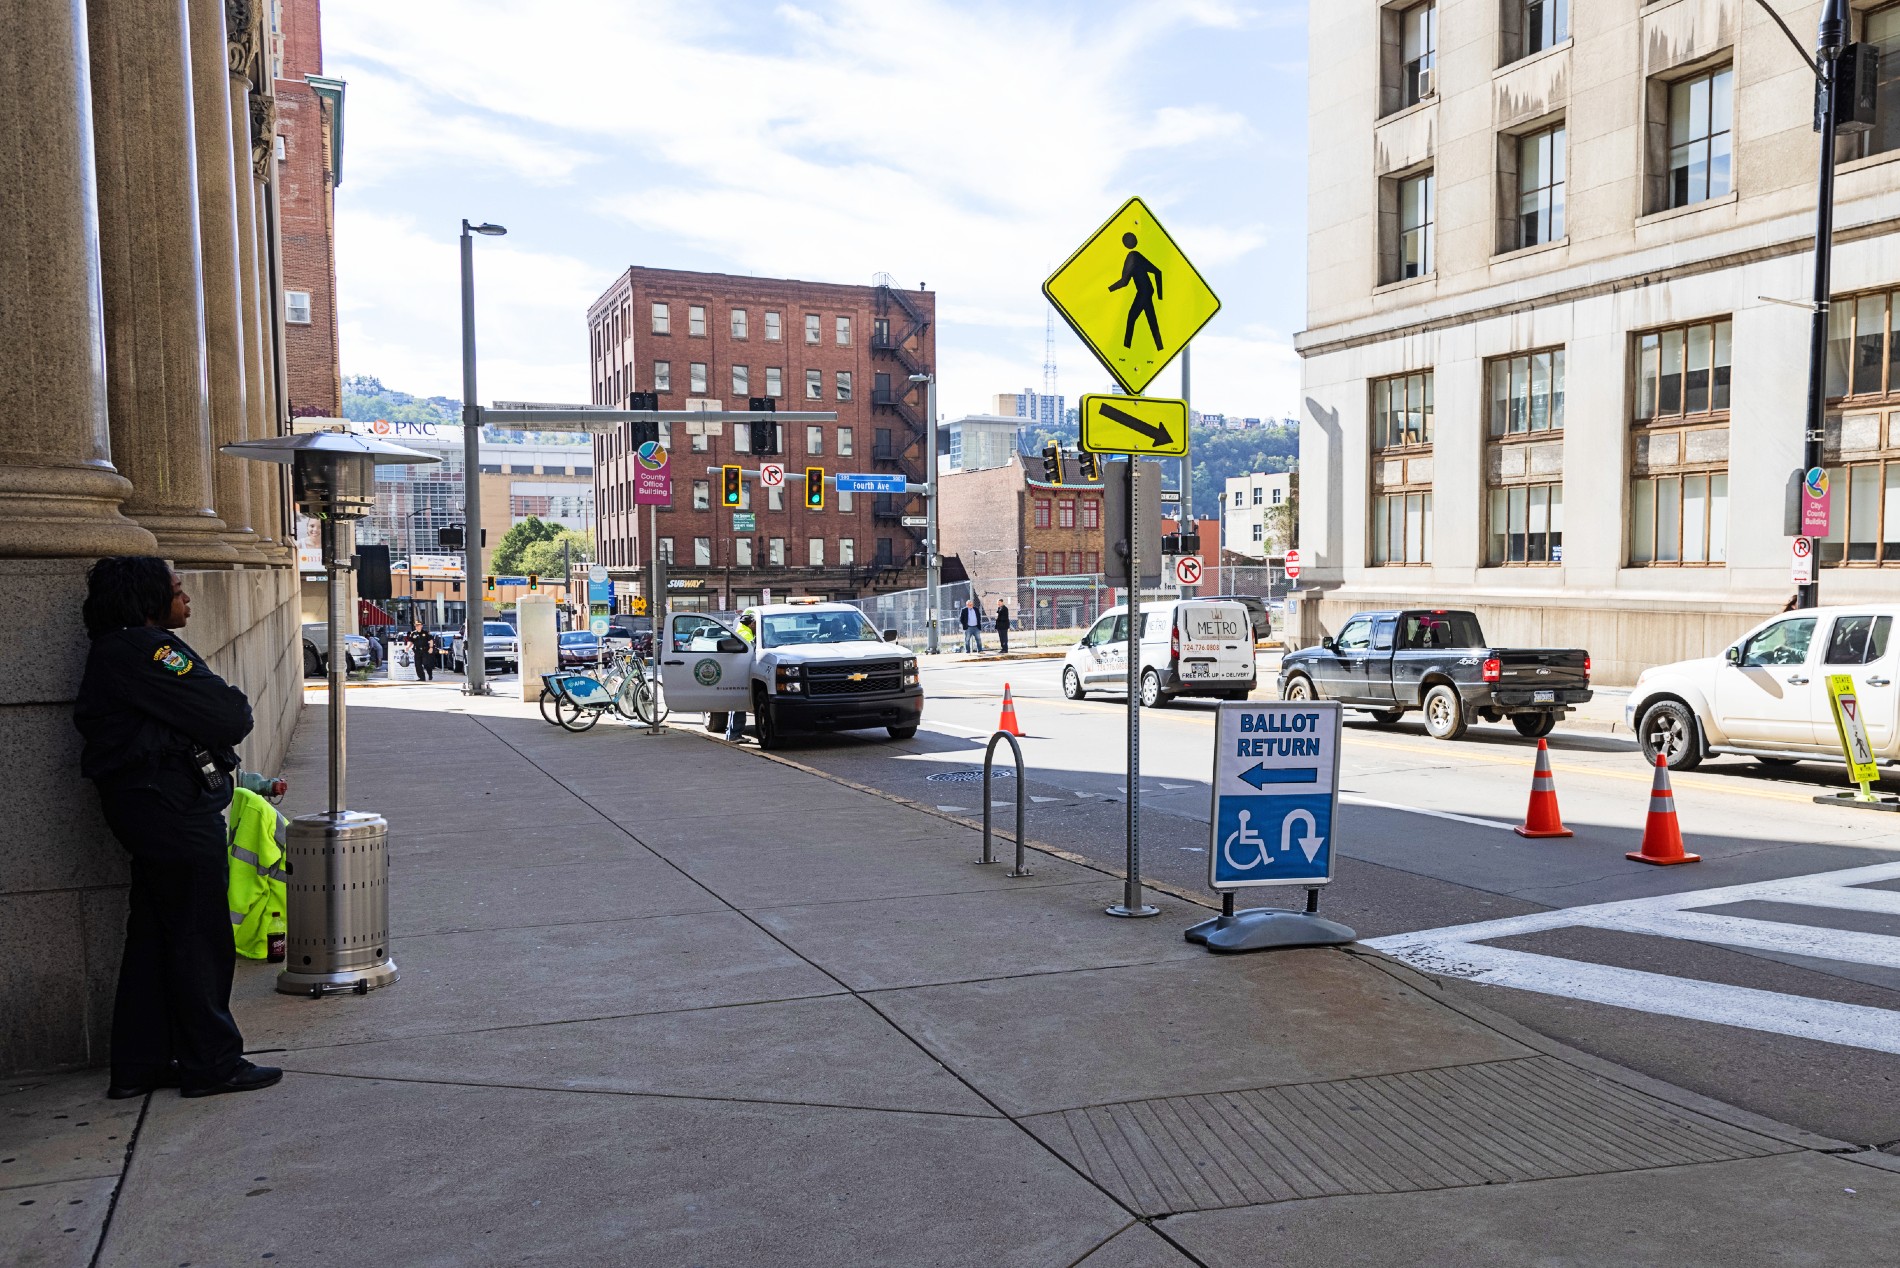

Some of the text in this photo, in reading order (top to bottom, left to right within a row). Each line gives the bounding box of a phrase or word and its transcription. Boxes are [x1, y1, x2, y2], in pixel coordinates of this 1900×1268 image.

[395, 421, 436, 436] PNC
[641, 473, 666, 481] County
[853, 481, 890, 490] Fourth Ave
[639, 488, 668, 496] Building
[1810, 501, 1823, 510] City-
[1806, 509, 1826, 518] County
[1805, 518, 1827, 526] Building
[667, 579, 705, 588] SUBWAY
[1197, 621, 1237, 635] METRO
[1240, 713, 1320, 733] BALLOT
[1237, 737, 1320, 757] RETURN
